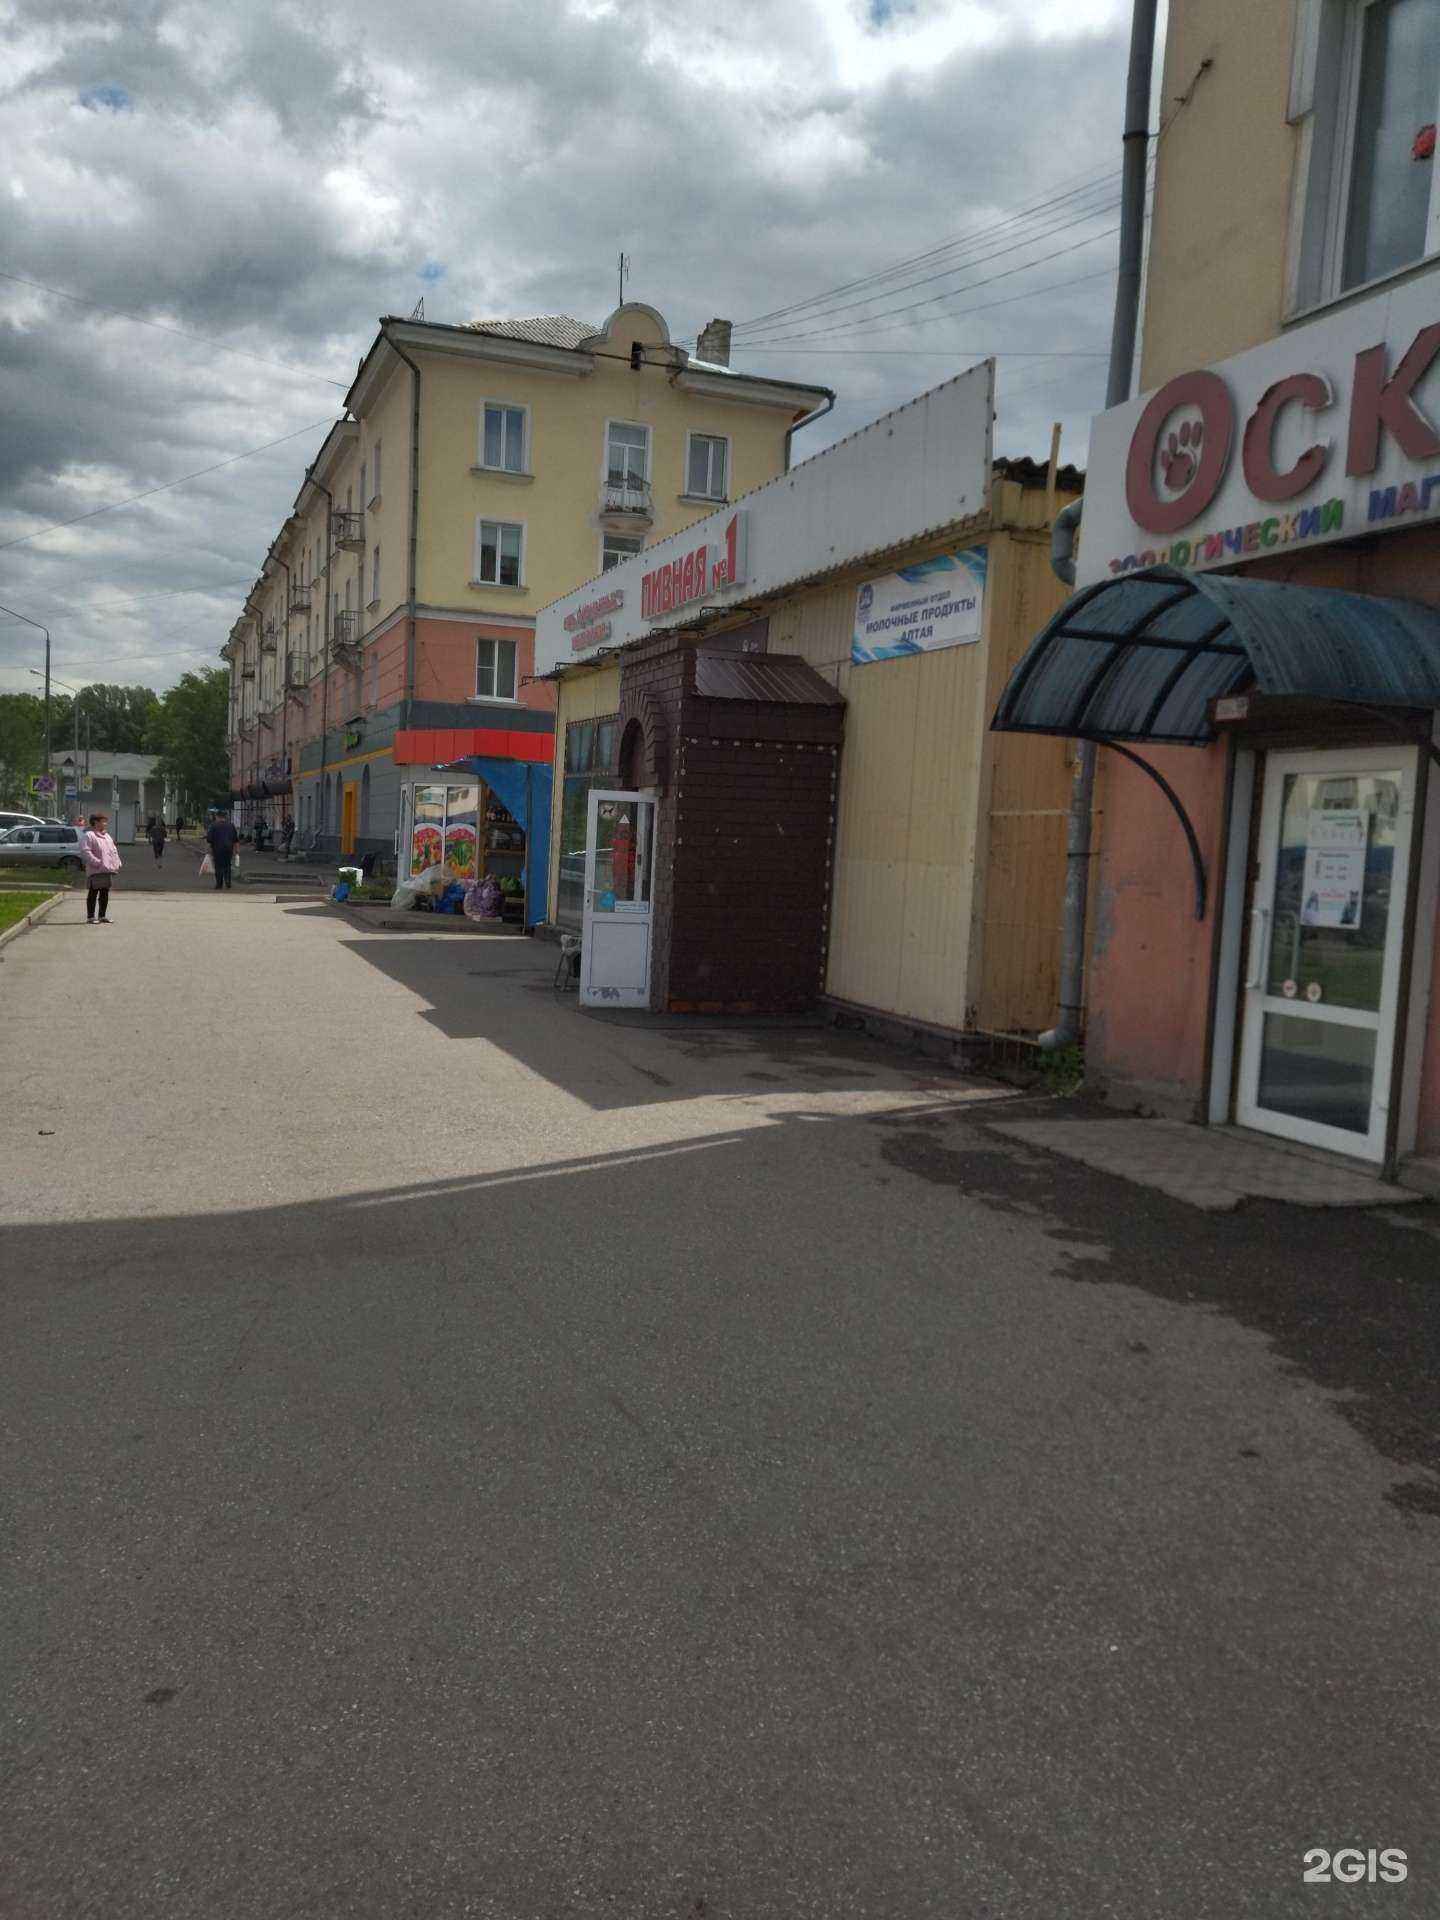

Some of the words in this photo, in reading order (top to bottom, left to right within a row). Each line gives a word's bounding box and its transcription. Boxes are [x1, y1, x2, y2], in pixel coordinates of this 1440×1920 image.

[641, 544, 708, 620] ПИВНАЯ
[865, 611, 919, 634] МОЛОЧНЫЕ
[921, 597, 976, 620] ПРОДУКТЫ
[900, 625, 933, 641] АЛТАЯ
